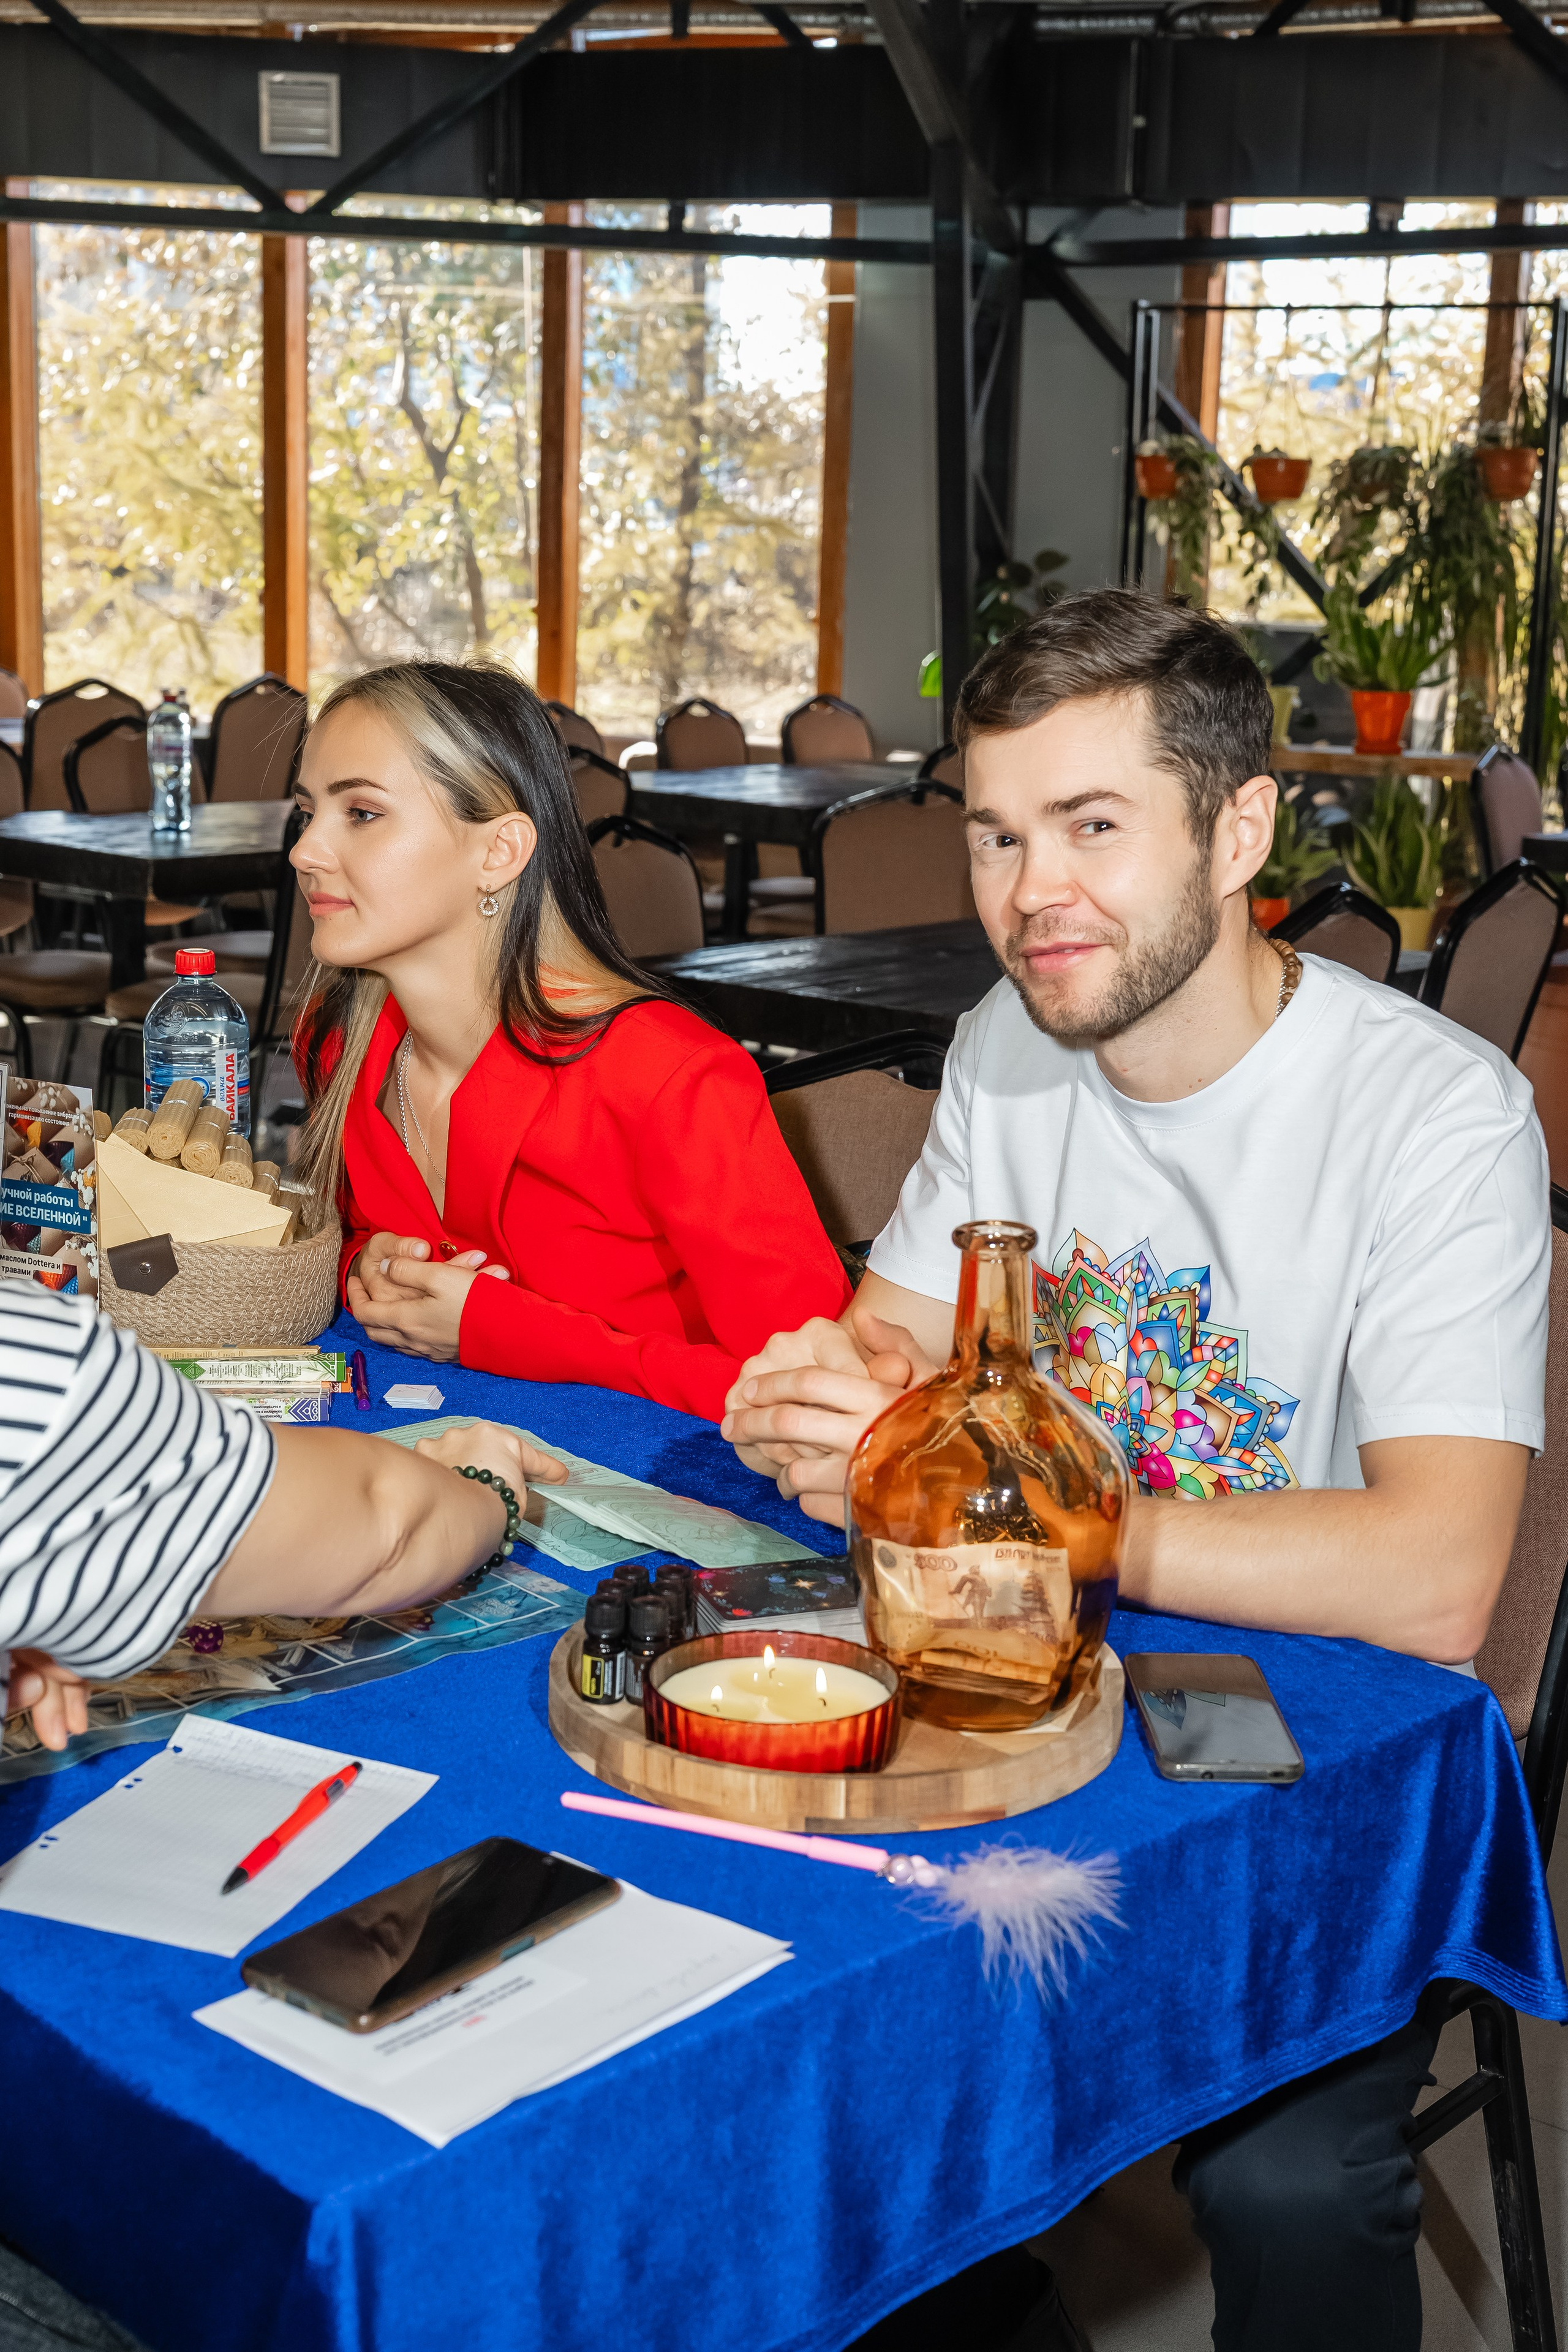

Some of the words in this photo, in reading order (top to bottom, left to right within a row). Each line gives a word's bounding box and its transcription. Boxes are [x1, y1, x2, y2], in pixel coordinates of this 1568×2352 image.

[9, 1112, 44, 1122] гармонизацию
[29, 1107, 57, 1115] повышение
[57, 1111, 80, 1120] вибраций
[1, 1187, 32, 1200] учной
[34, 1192, 74, 1207] работы
[15, 1204, 81, 1226] ВСЕЛЕННОЙ
[0, 1254, 26, 1264] маслом
[28, 1257, 55, 1268] Dottera
[1, 1265, 31, 1276] травами
